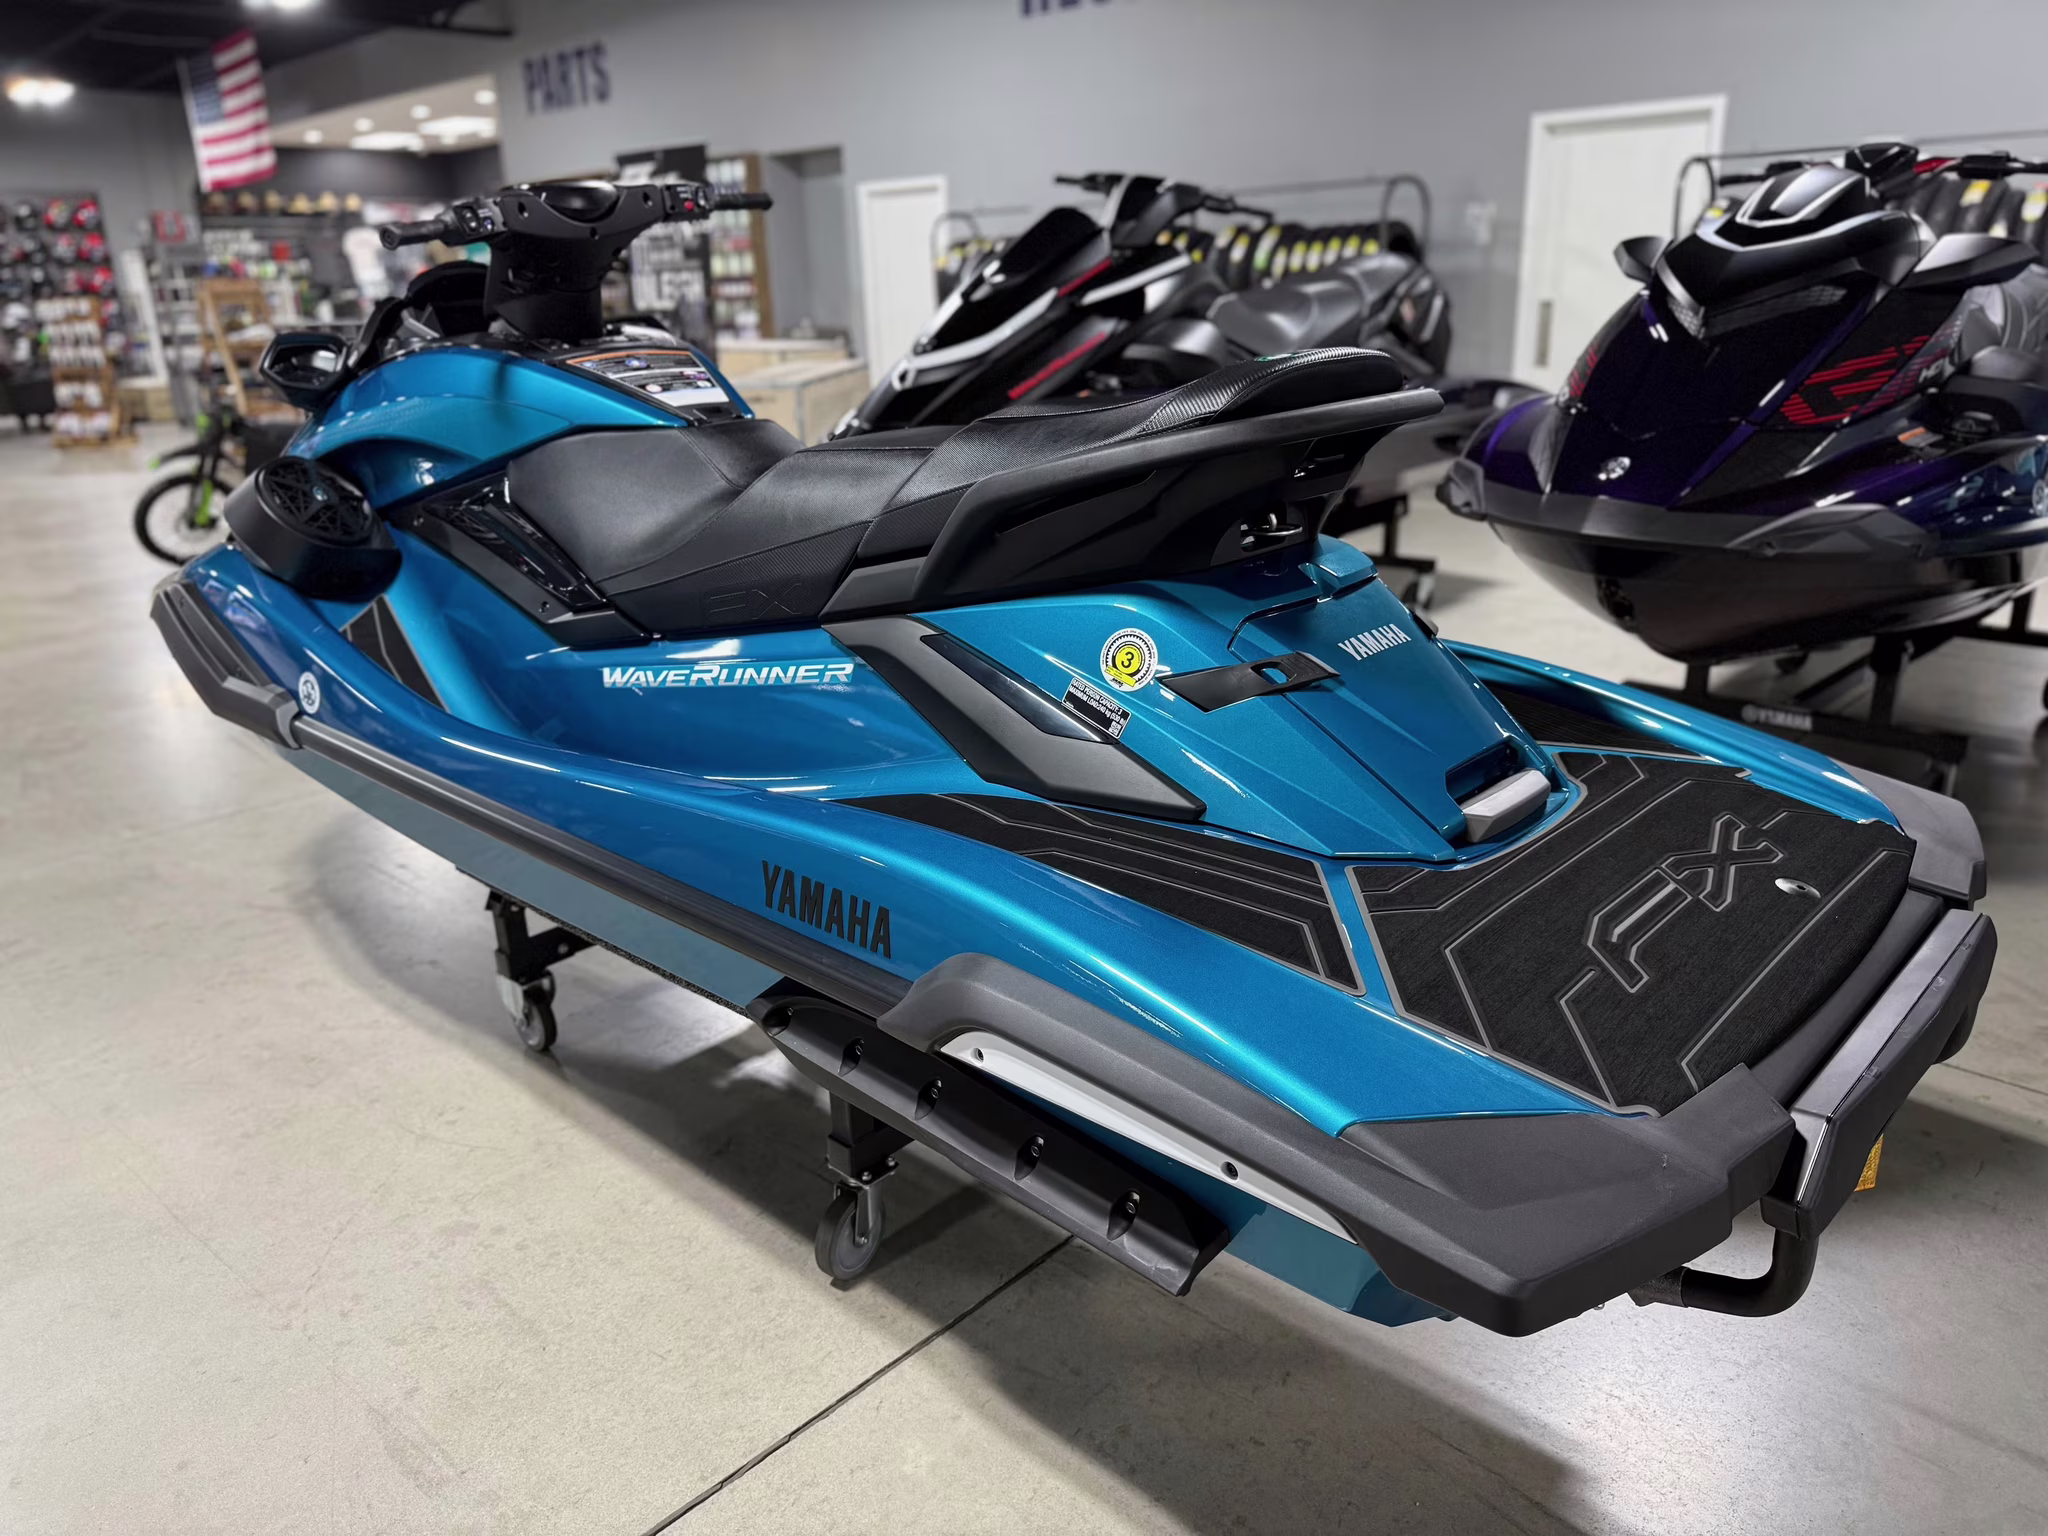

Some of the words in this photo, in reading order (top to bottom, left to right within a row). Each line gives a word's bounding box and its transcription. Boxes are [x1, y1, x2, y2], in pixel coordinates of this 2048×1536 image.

[522, 42, 612, 116] PARTS
[1337, 623, 1412, 661] YAMAHA
[601, 662, 854, 688] WAVERUNNER
[1120, 651, 1134, 669] 3
[1068, 685, 1089, 702] MAXIMUM
[1072, 678, 1085, 690] RATED
[1083, 686, 1101, 701] PERSON
[761, 859, 892, 960] YAMAHA
[1586, 812, 1786, 995] FX
